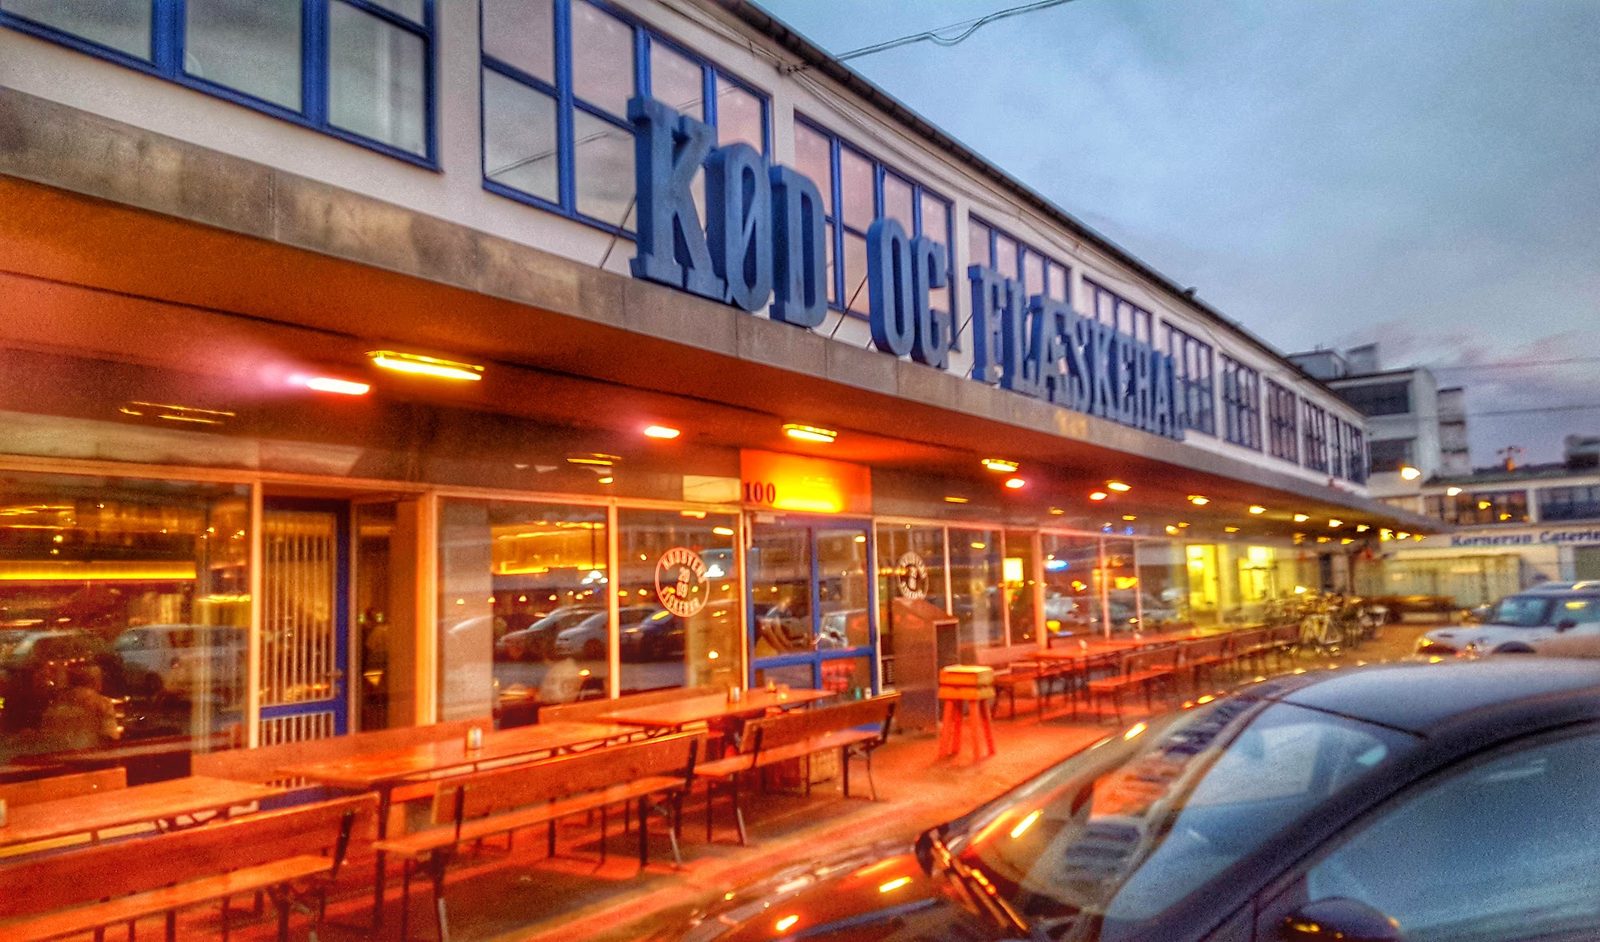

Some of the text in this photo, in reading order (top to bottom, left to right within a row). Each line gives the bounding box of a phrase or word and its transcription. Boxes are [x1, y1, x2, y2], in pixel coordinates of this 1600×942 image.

[627, 95, 827, 328] KØD
[866, 217, 949, 370] OG
[744, 481, 776, 504] 100
